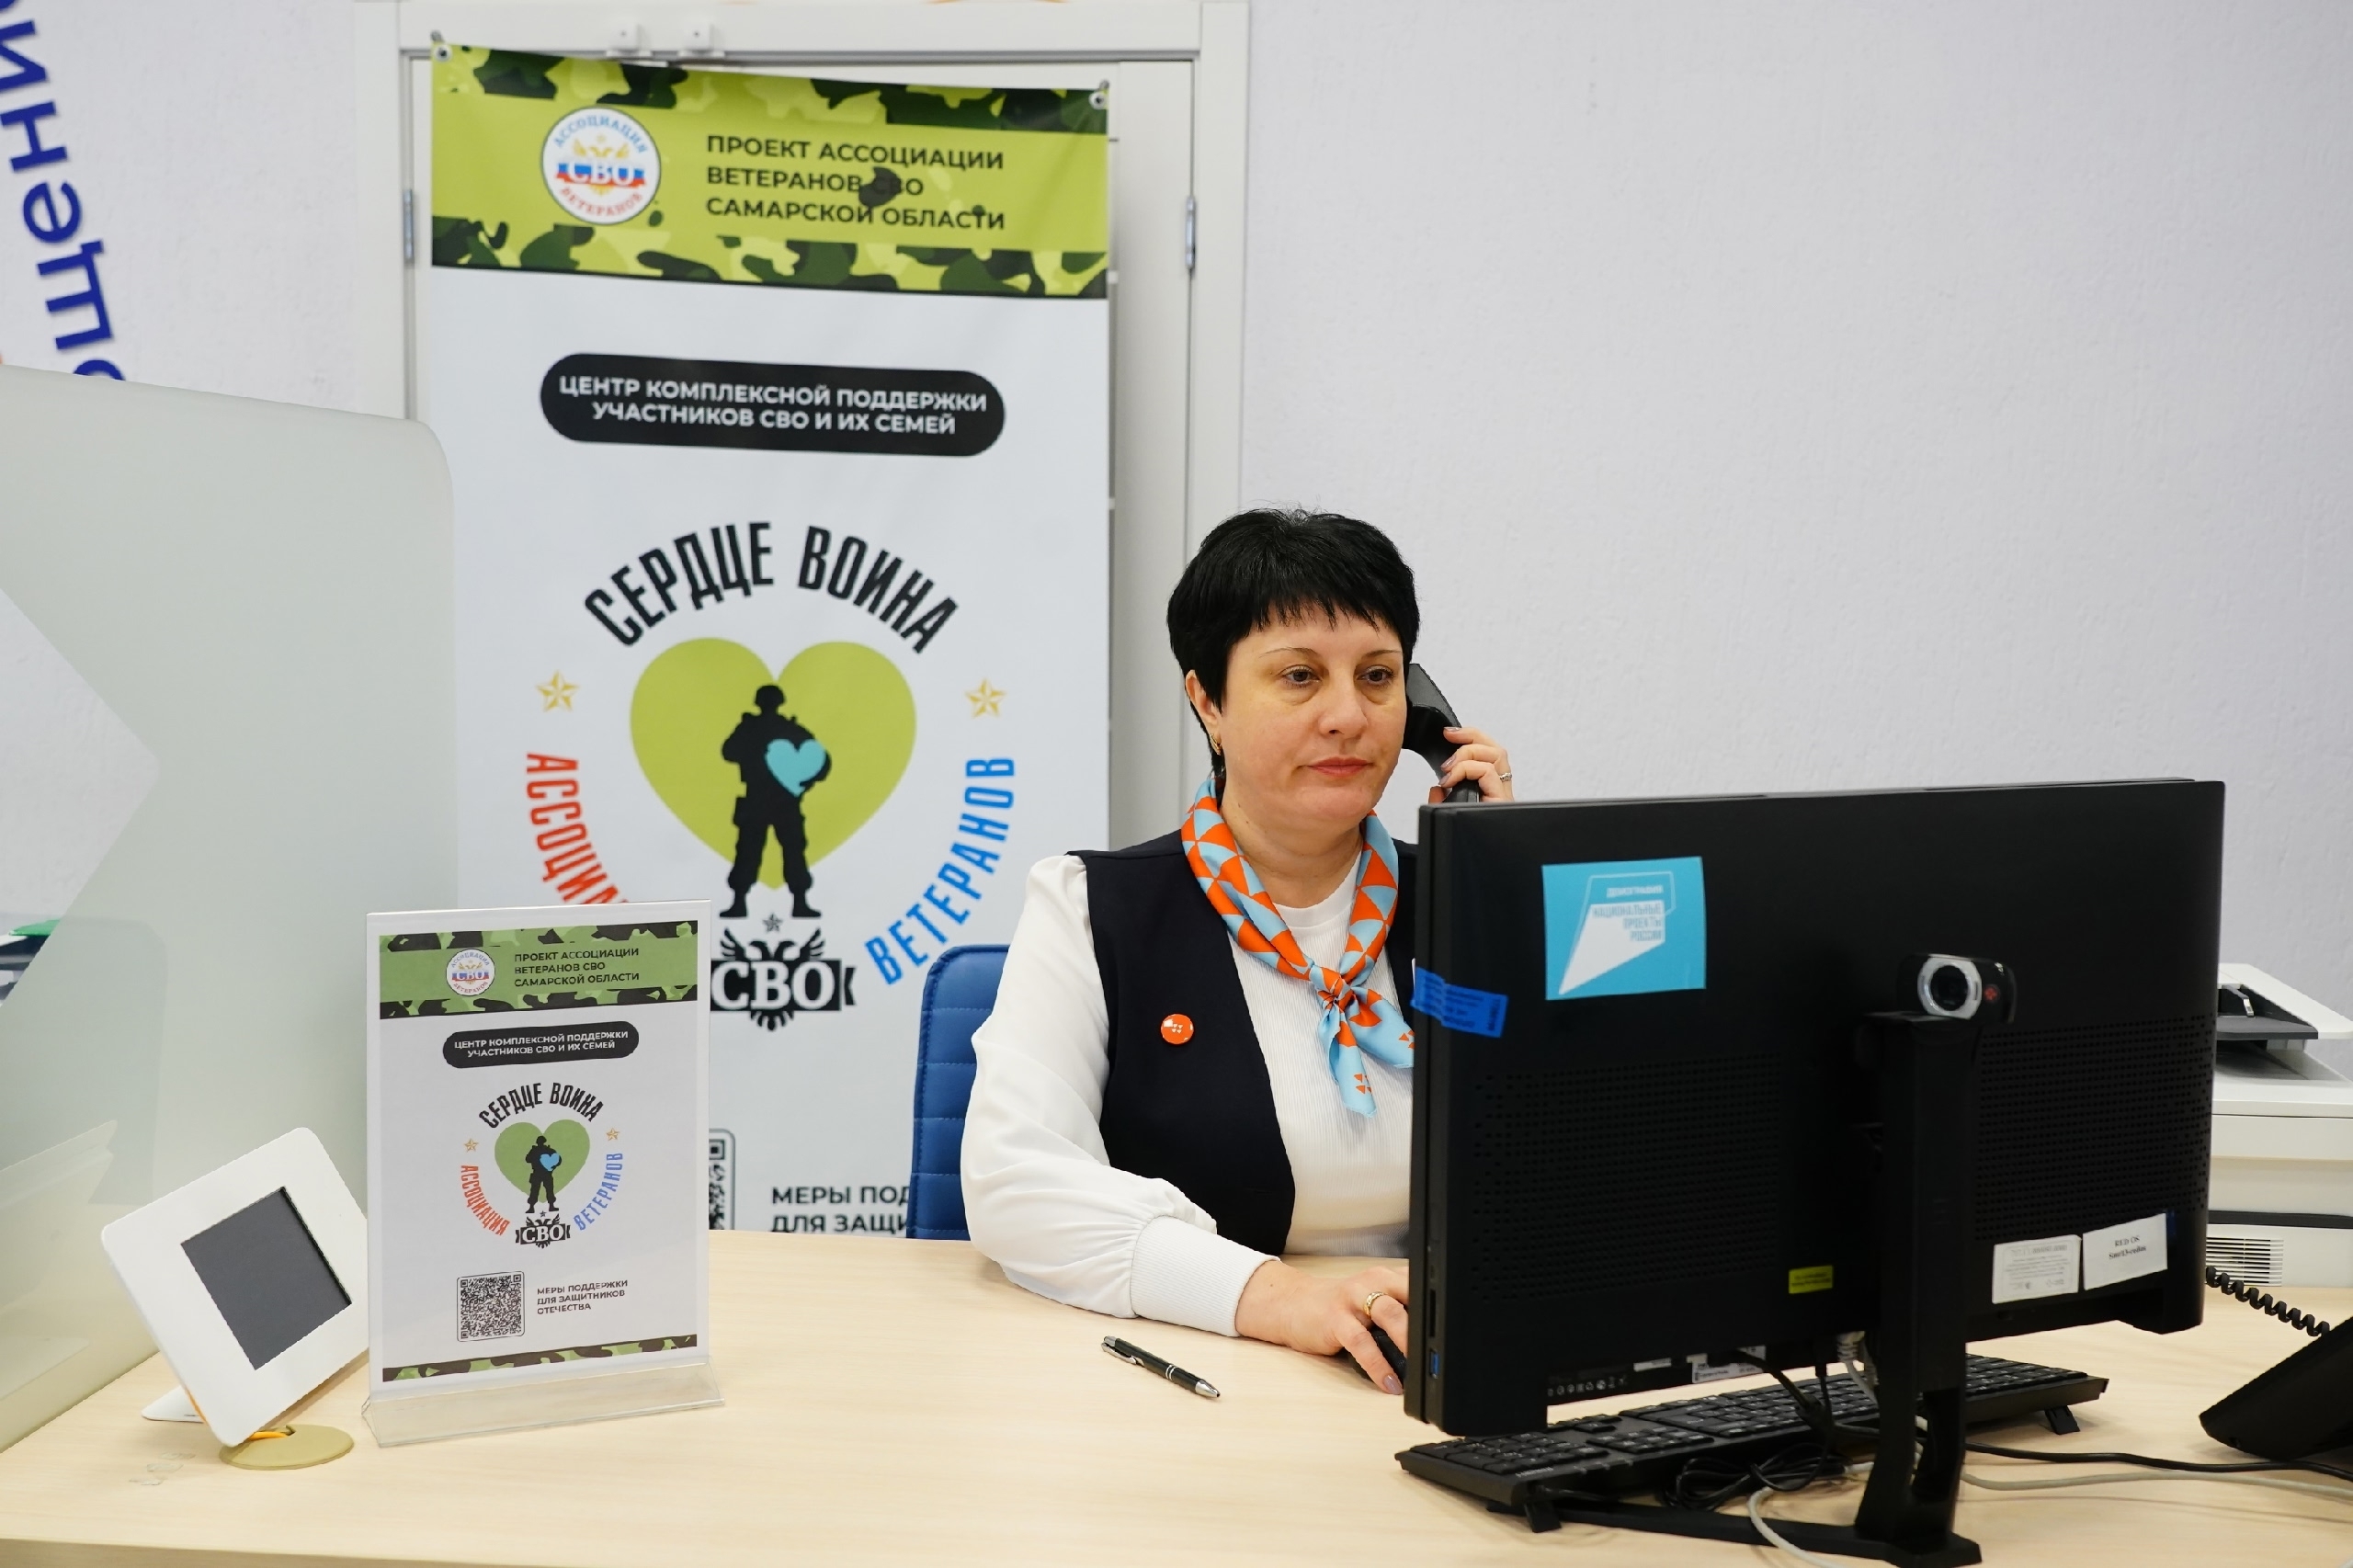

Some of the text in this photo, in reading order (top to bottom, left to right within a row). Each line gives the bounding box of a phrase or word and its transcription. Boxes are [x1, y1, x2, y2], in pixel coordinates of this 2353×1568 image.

[707, 134, 1004, 170] ПРОЕКТ АССОЦИАЦИИ
[566, 160, 635, 187] СВО
[707, 166, 862, 191] ВЕТЕРАНОВ
[0, 0, 126, 381] щени
[706, 198, 1005, 229] САМАРСКОЙ ОБЛАСТИ
[559, 376, 987, 413] ЦЕНТР КОМПЛЕКСНОЙ ПОДДЕРЖКИ
[592, 402, 957, 435] УЧАСТНИКОВ СВО И ИХ СЕМЕЙ
[585, 522, 959, 653] СЕРДЦЕ ВОИНА
[866, 757, 1016, 986] ВЕТЕРАНОВ
[515, 948, 639, 962] ПРОЕКТ АССОЦИАЦИИ
[515, 961, 606, 974] ВЕТЕРАНОВ СВО
[515, 972, 640, 987] САМАРСКОЙ ОБЛАСТИ
[710, 961, 835, 1011] СВО
[454, 1030, 629, 1049] ЦЕНТР КОМПЛЕКСНОЙ ПОДДЕРЖКИ
[467, 1046, 533, 1058] УЧАСТНИКОВ
[536, 1045, 556, 1053] СВО
[567, 1043, 581, 1051] ИХ
[582, 1040, 616, 1050] СЕМЕЙ
[479, 1082, 604, 1129] СЕРДЦЕ ВОИНА
[460, 1165, 511, 1236] АССОЦИАЦИЯ
[573, 1153, 624, 1231] ВЕТЕРАНОВ
[771, 1187, 851, 1205] МЕРЫ
[521, 1224, 565, 1243] СВО
[770, 1214, 825, 1233] ДЛЯ
[537, 1279, 628, 1295] МЕРЫ ПОДДЕРЖКИ
[537, 1290, 625, 1305] ДЛЯ ЗАЩИТНИКОВ
[537, 1302, 592, 1315] ОТЕЧЕСТВА
